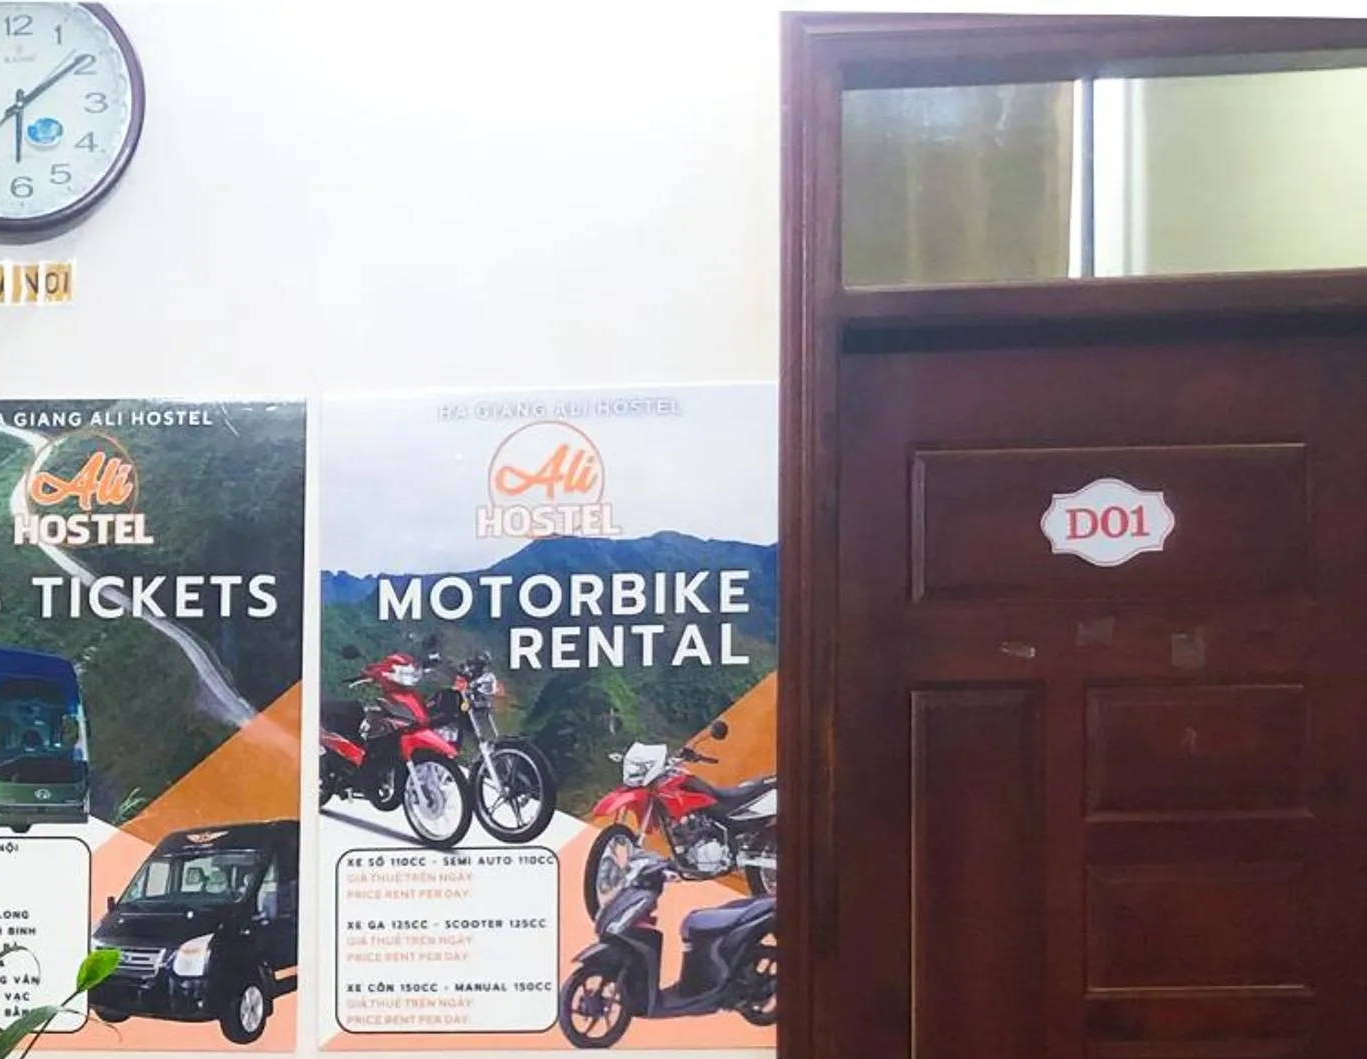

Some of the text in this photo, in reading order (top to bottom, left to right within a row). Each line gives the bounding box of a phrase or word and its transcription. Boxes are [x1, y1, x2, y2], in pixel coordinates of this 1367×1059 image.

[4, 14, 34, 36] 12
[54, 24, 63, 45] 1
[73, 54, 97, 75] 2
[84, 92, 109, 114] 3
[74, 132, 99, 153] 4
[49, 163, 72, 185] 5
[10, 176, 34, 198] 6
[13, 411, 82, 426] GIANG
[89, 411, 123, 426] ALI
[132, 410, 214, 426] HOSTEL
[438, 398, 682, 422] HA GIANG ALI HOSTEL
[31, 451, 134, 511] Ali
[494, 443, 599, 500] Ali
[13, 513, 155, 546] HOSTEL
[476, 503, 622, 539] HOSTEL
[1065, 504, 1150, 540] D01
[31, 574, 279, 620] TICKETS
[377, 569, 751, 622] MOTORBIKE
[509, 622, 751, 669] RENTAL
[347, 858, 363, 867] XE
[390, 857, 427, 867] 110CC
[442, 856, 472, 867] SEMI
[477, 856, 513, 865] AUTO
[518, 856, 555, 865] 110CC
[347, 918, 547, 930] XE GA 125CC SCOOTER 125CC
[346, 983, 362, 993] XE
[400, 983, 438, 993] 150CC
[454, 982, 508, 992] MANUAL
[513, 981, 553, 992] 150CC
